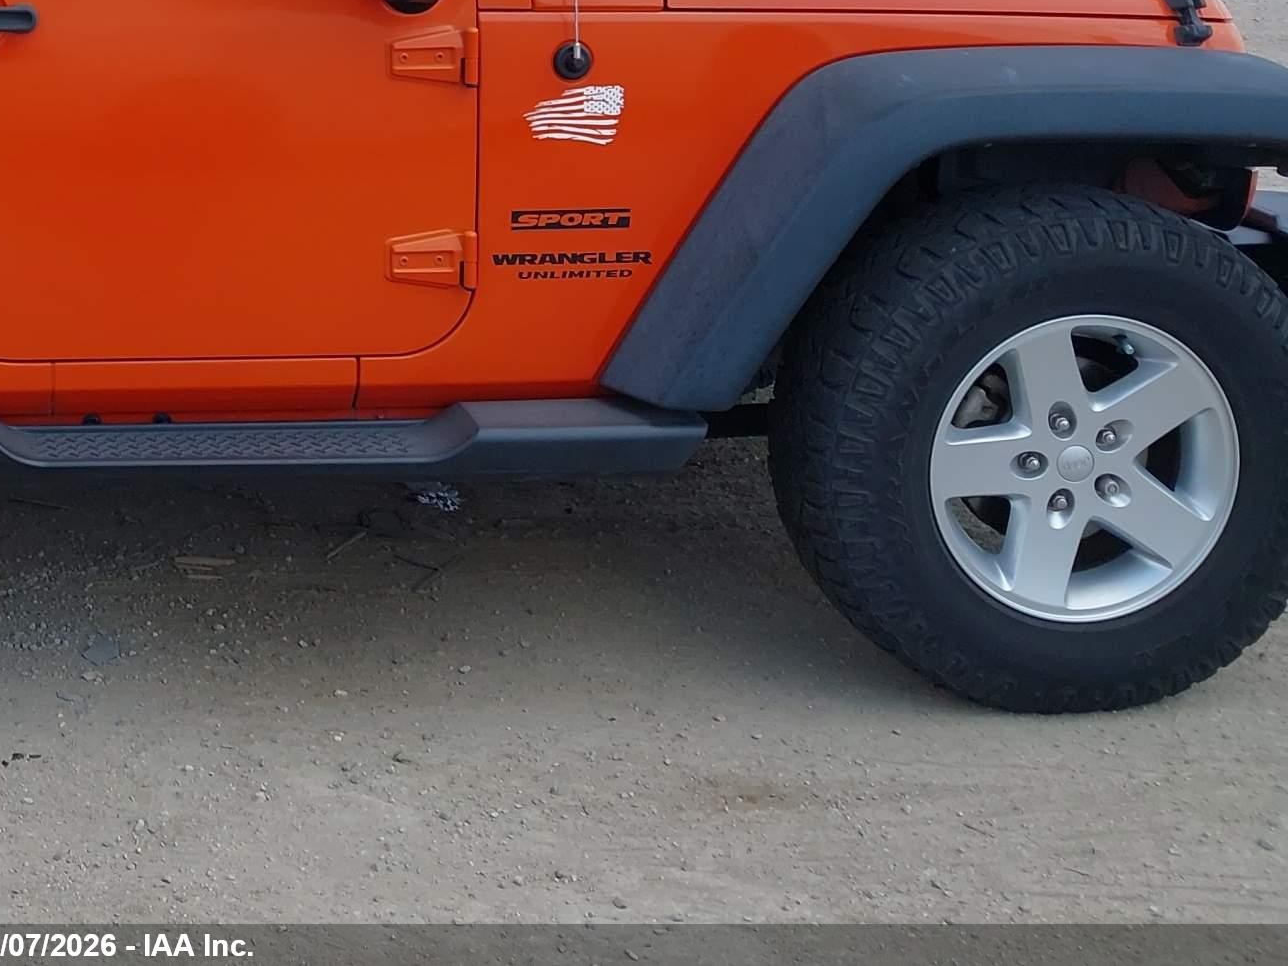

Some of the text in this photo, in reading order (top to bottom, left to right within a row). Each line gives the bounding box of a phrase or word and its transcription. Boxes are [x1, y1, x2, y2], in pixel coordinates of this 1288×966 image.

[512, 211, 630, 228] SPORT
[492, 251, 653, 266] WRANGLER
[518, 269, 633, 280] UNLIMITED
